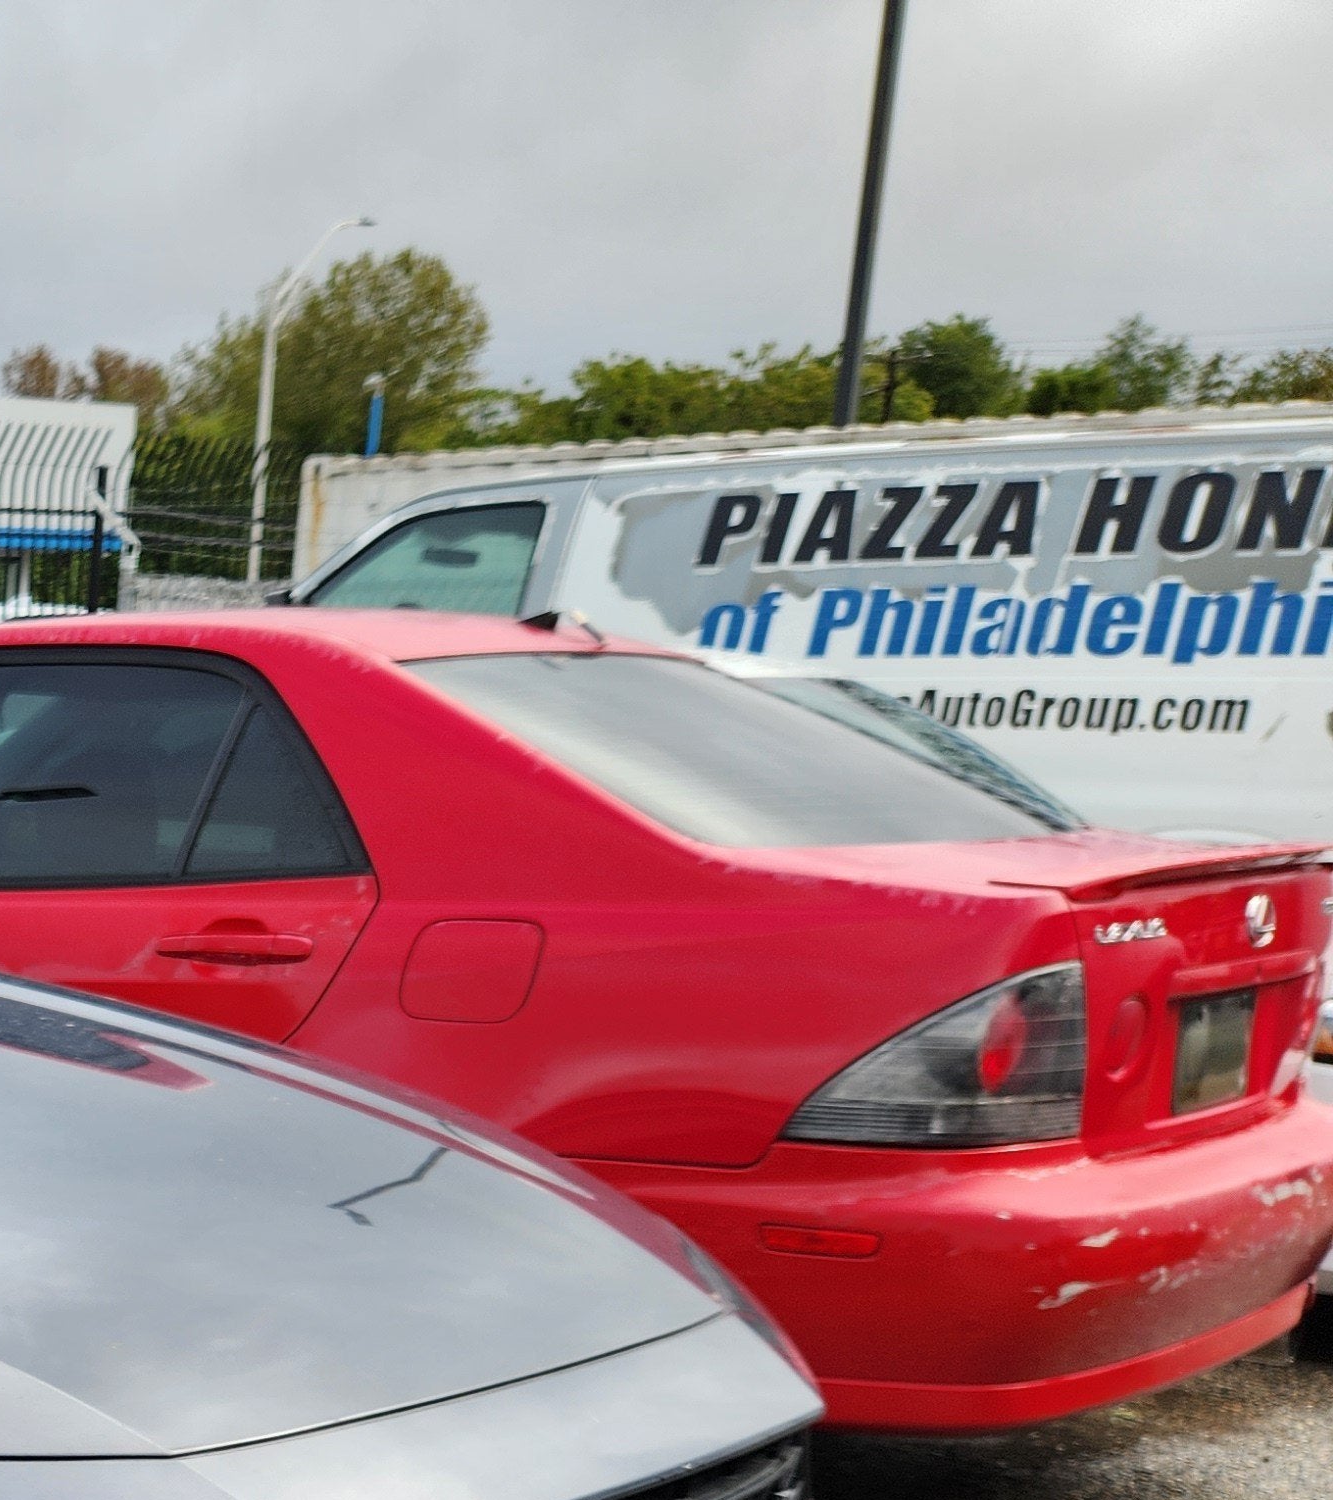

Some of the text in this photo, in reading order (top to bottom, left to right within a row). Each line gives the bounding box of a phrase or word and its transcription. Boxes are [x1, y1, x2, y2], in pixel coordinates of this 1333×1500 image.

[697, 467, 1333, 566] PIAZZA HON
[698, 580, 1333, 665] of Philadelphi
